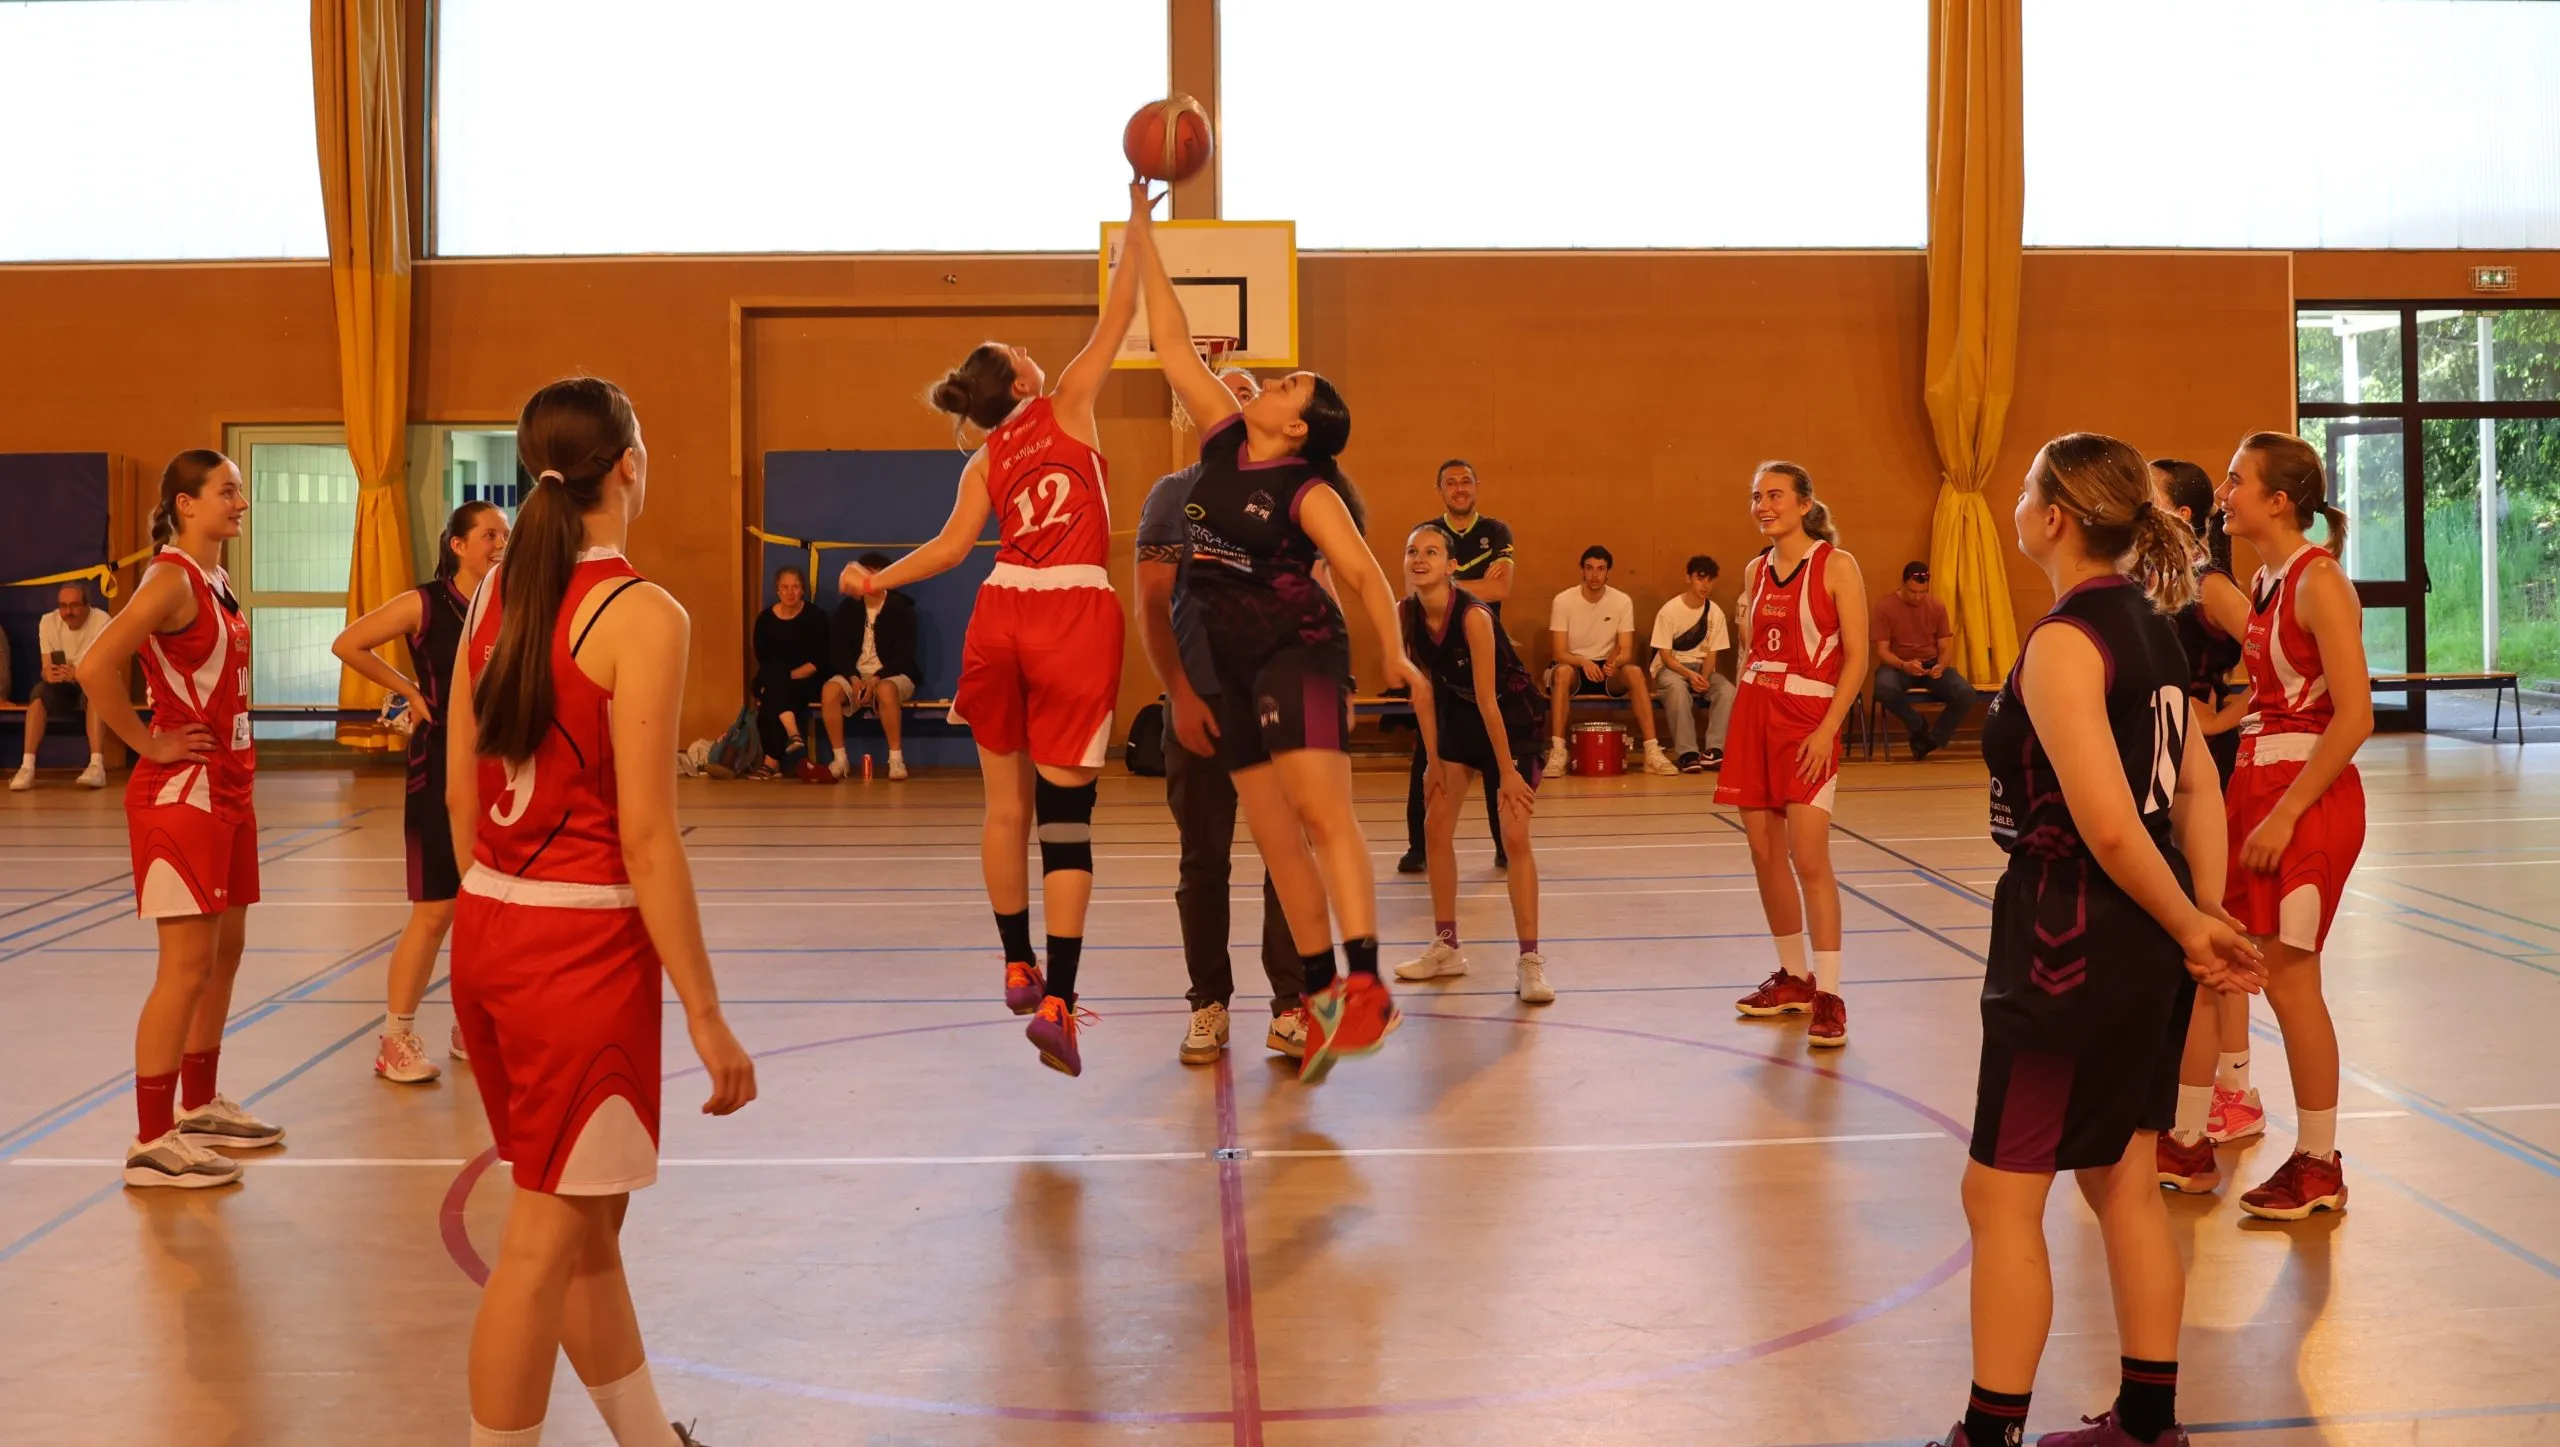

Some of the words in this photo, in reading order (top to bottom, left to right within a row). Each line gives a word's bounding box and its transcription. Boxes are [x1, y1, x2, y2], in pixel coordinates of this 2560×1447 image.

[1013, 472, 1073, 537] 12
[1767, 628, 1781, 651] 8
[237, 666, 248, 696] 10
[2143, 685, 2184, 815] 10
